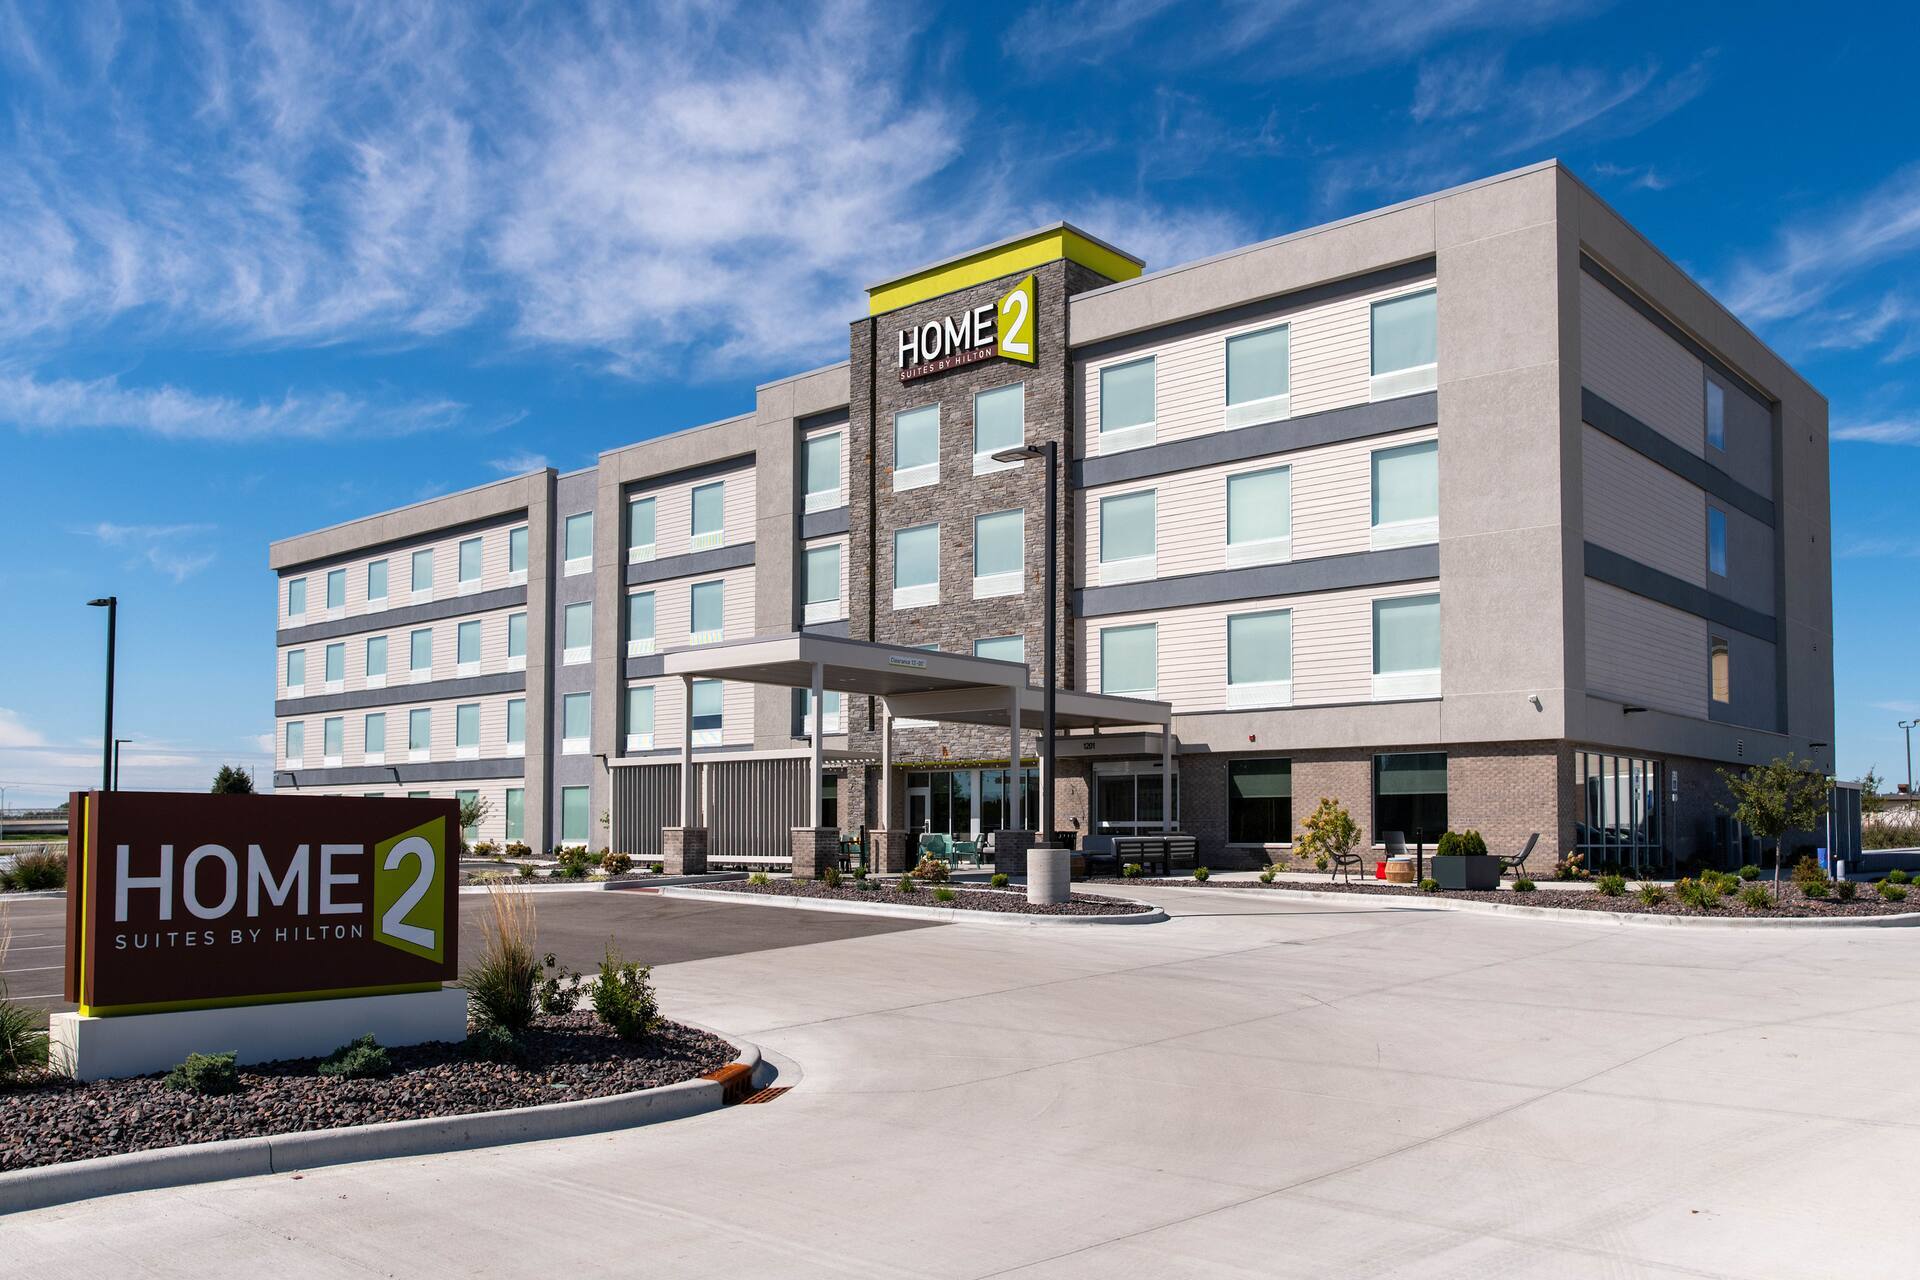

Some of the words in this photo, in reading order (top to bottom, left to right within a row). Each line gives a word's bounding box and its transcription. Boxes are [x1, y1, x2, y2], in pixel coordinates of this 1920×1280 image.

[899, 303, 994, 368] HOME
[1002, 290, 1029, 355] 2
[900, 366, 934, 380] SUITES
[939, 360, 951, 369] BY
[955, 348, 992, 364] HILTON
[114, 843, 364, 922] HOME
[381, 836, 436, 951] 2
[115, 930, 214, 950] SUITES
[231, 929, 261, 944] BY
[275, 924, 363, 942] HILTON
